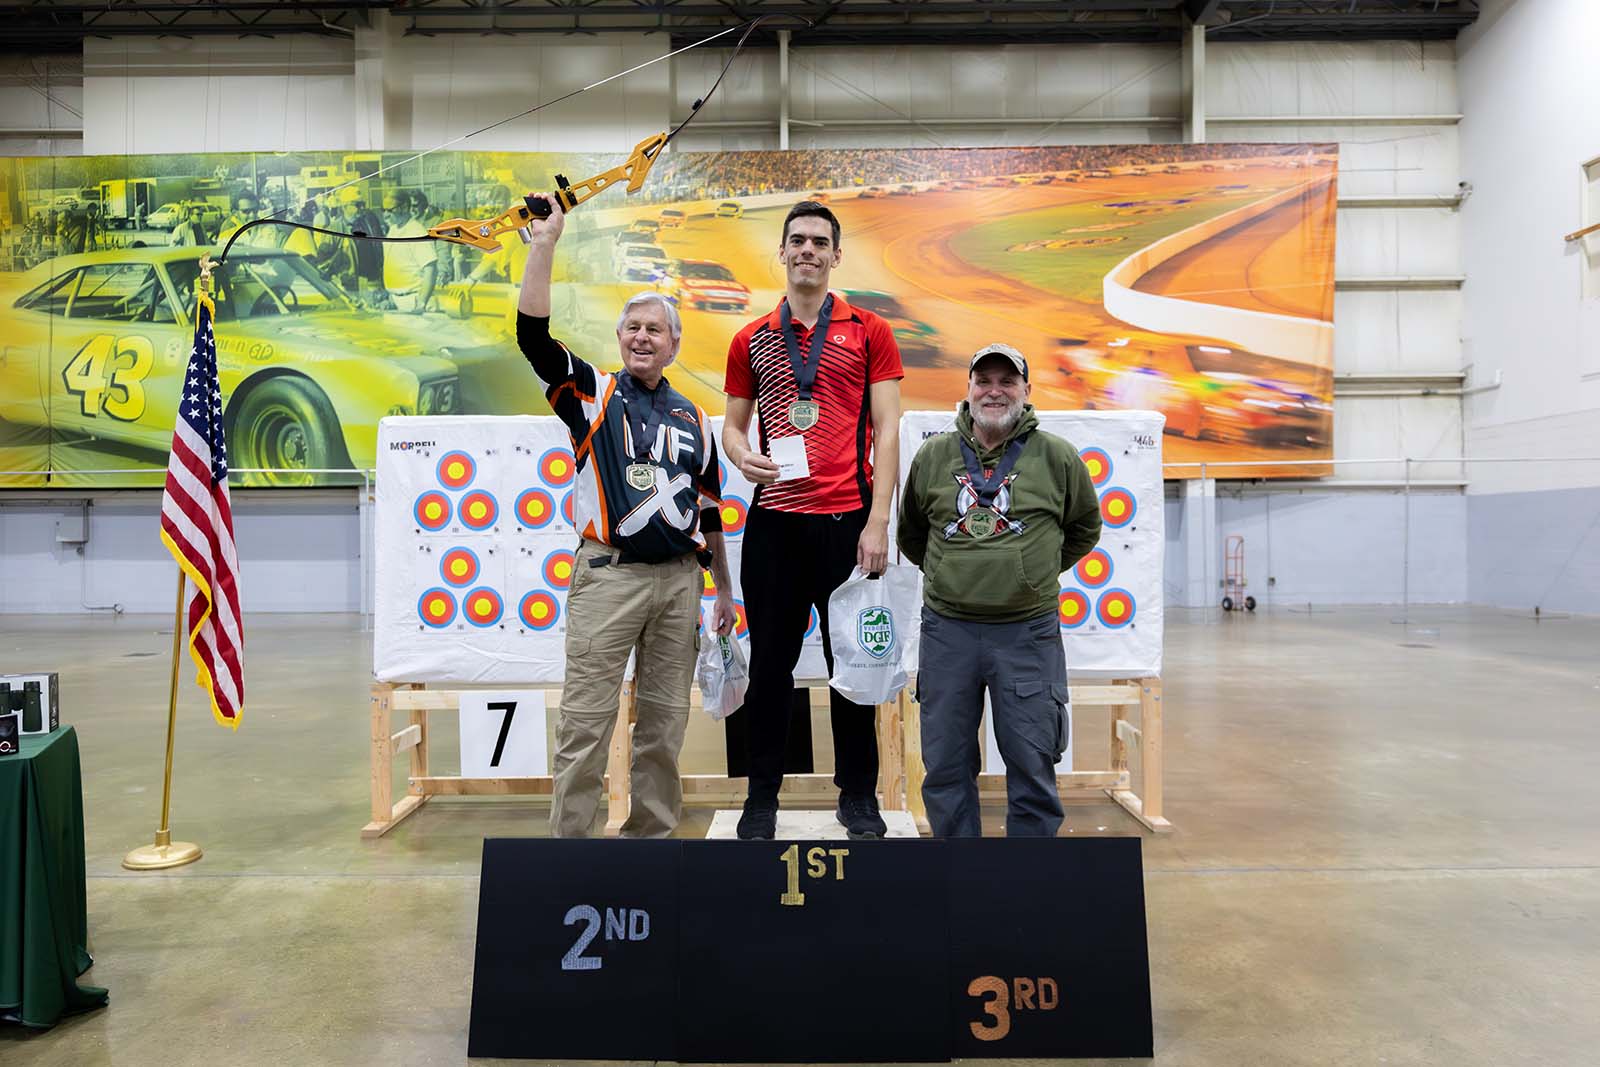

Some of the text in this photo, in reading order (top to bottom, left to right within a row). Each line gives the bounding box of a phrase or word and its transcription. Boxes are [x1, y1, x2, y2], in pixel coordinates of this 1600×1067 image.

[62, 332, 154, 423] 43
[487, 701, 518, 768] 7
[780, 844, 850, 906] 1ST
[561, 904, 651, 970] 2ND
[967, 975, 1059, 1042] 3RD
